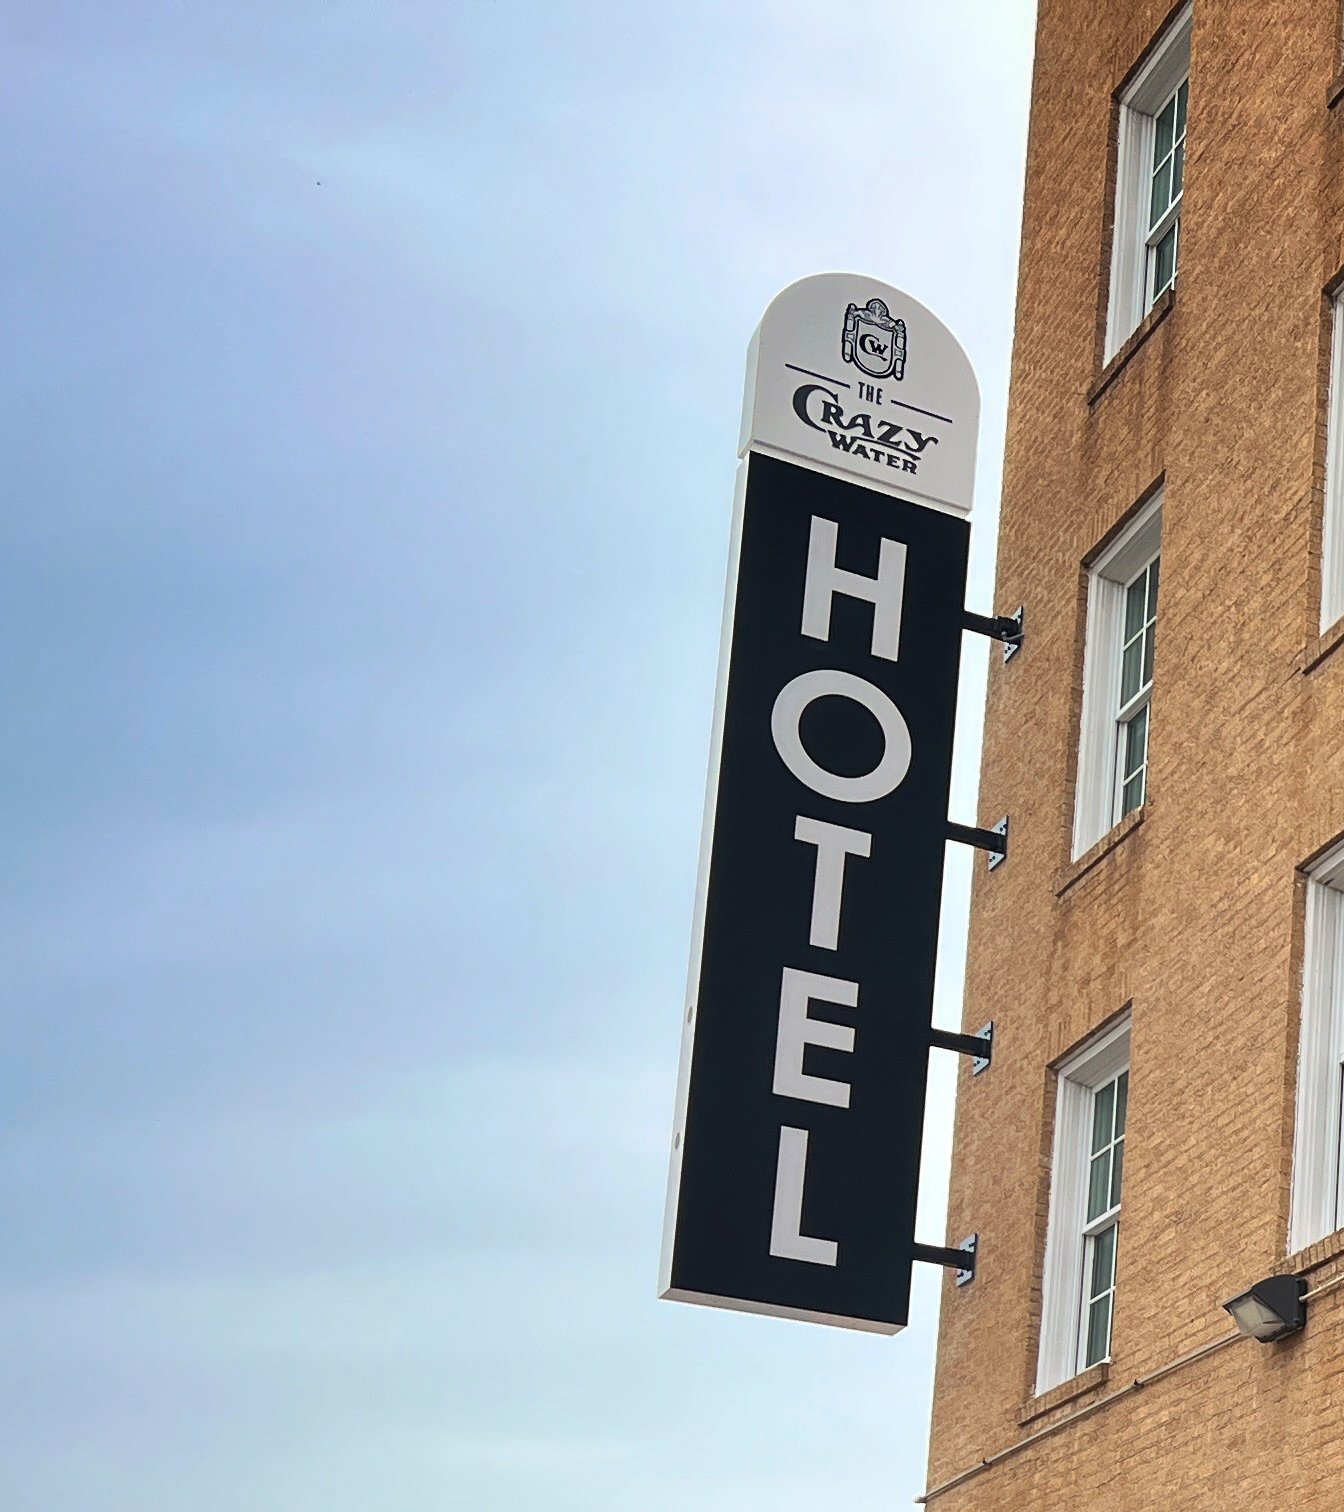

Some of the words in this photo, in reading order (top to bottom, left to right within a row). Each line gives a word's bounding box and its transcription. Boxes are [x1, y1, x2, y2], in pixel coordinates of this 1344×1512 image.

[792, 384, 939, 461] CRAZY
[858, 381, 884, 405] THE
[827, 430, 918, 475] WATER
[769, 514, 912, 1267] HOTEL
